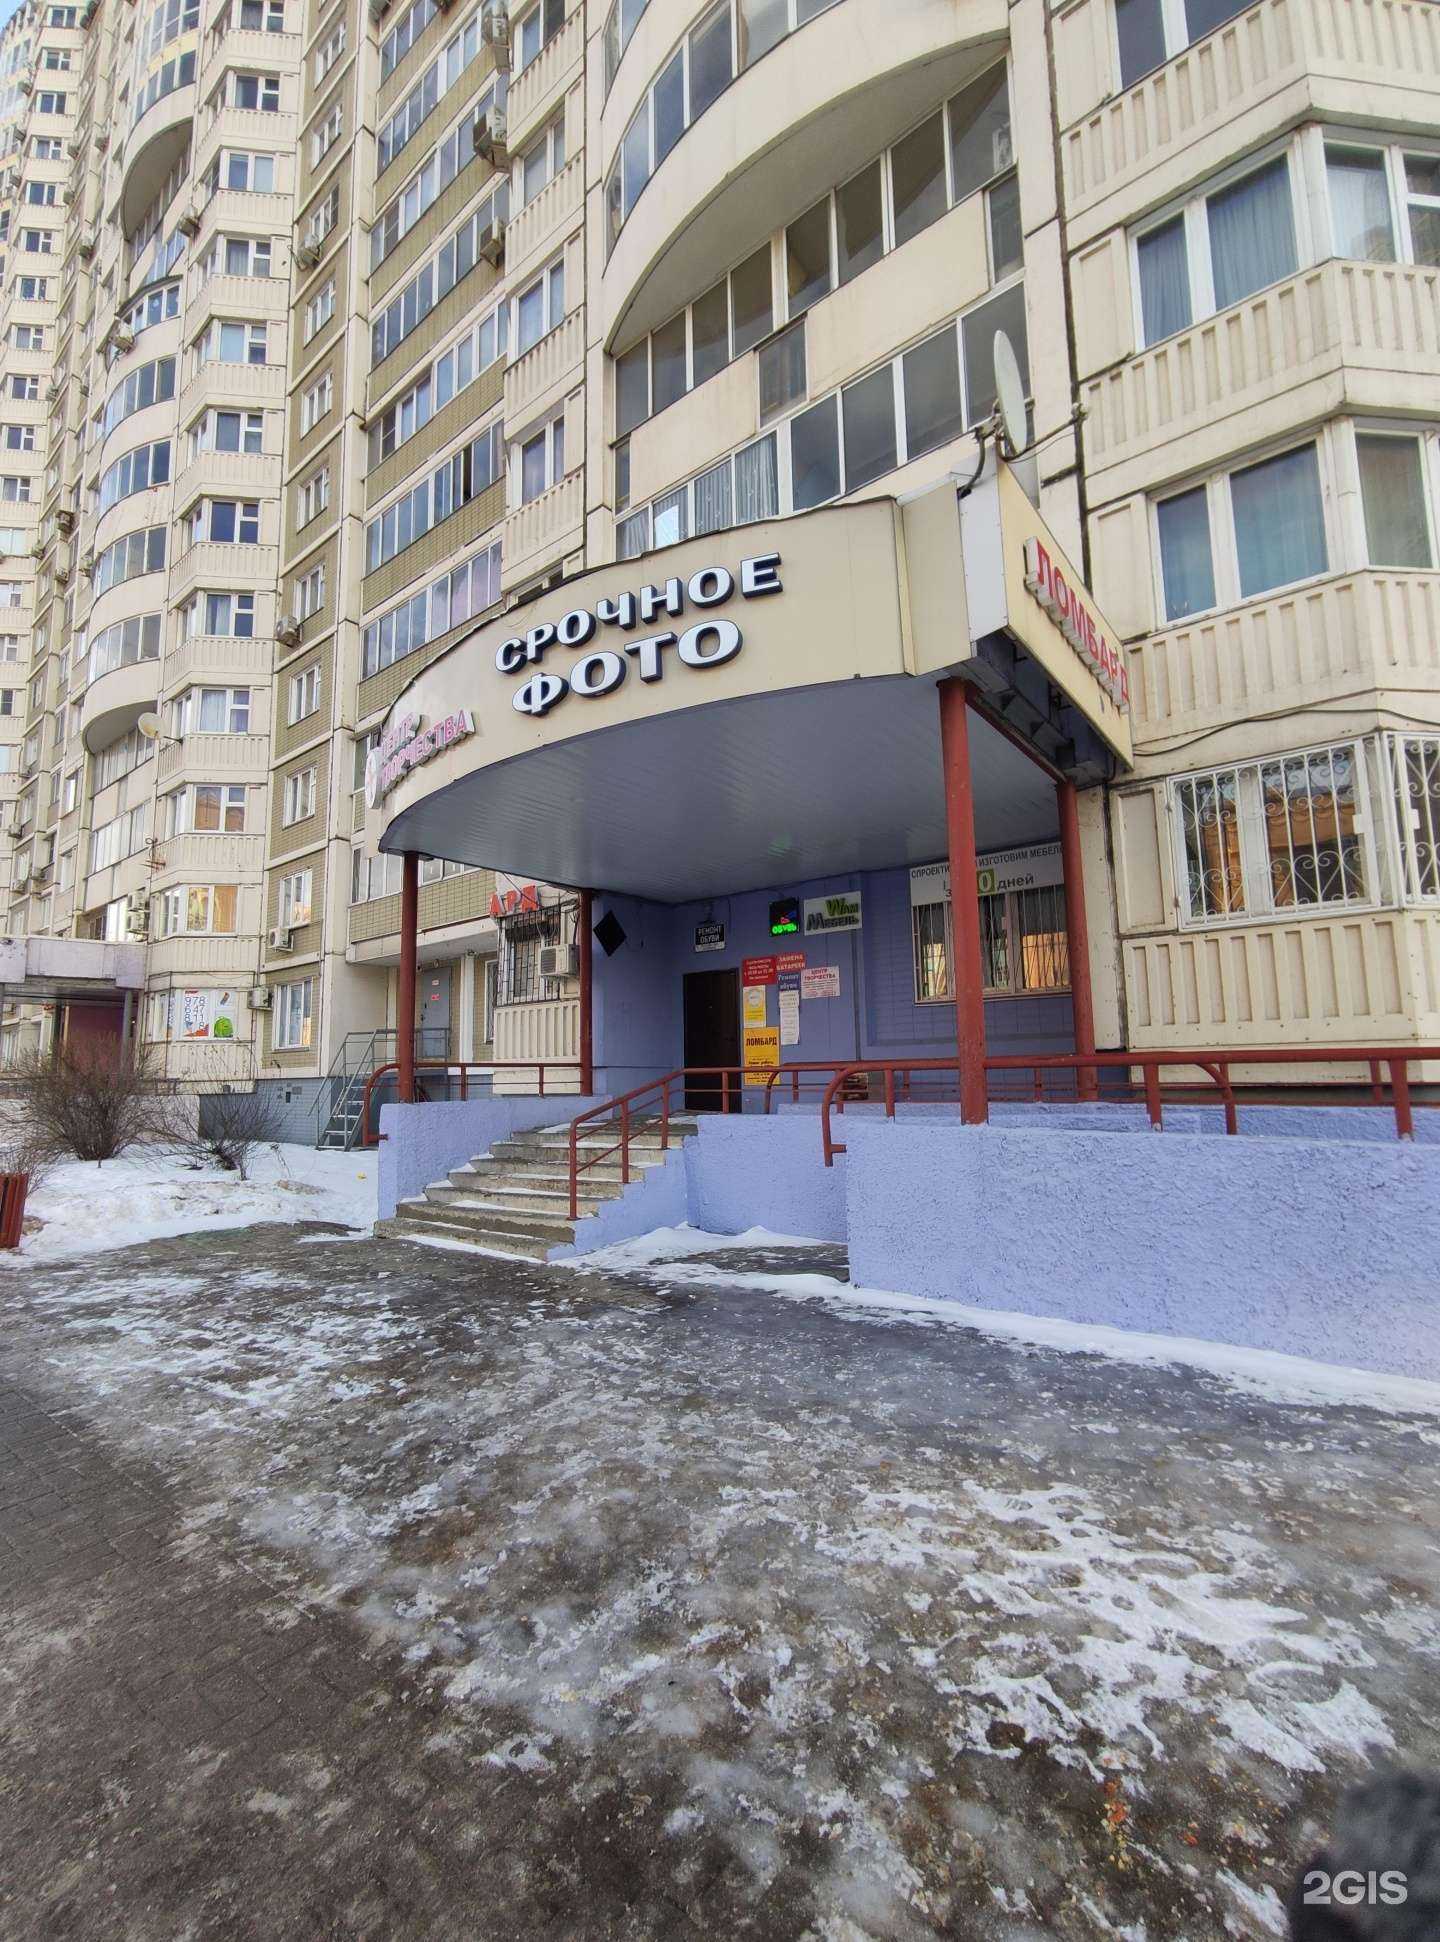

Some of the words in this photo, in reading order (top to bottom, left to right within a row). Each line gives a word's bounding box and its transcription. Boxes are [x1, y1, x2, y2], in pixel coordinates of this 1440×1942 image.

[494, 551, 783, 675] СРОЧНОЕ
[511, 618, 744, 717] ФОТО
[996, 873, 1034, 891] дней
[746, 1037, 778, 1046] ЛОМБАРД
